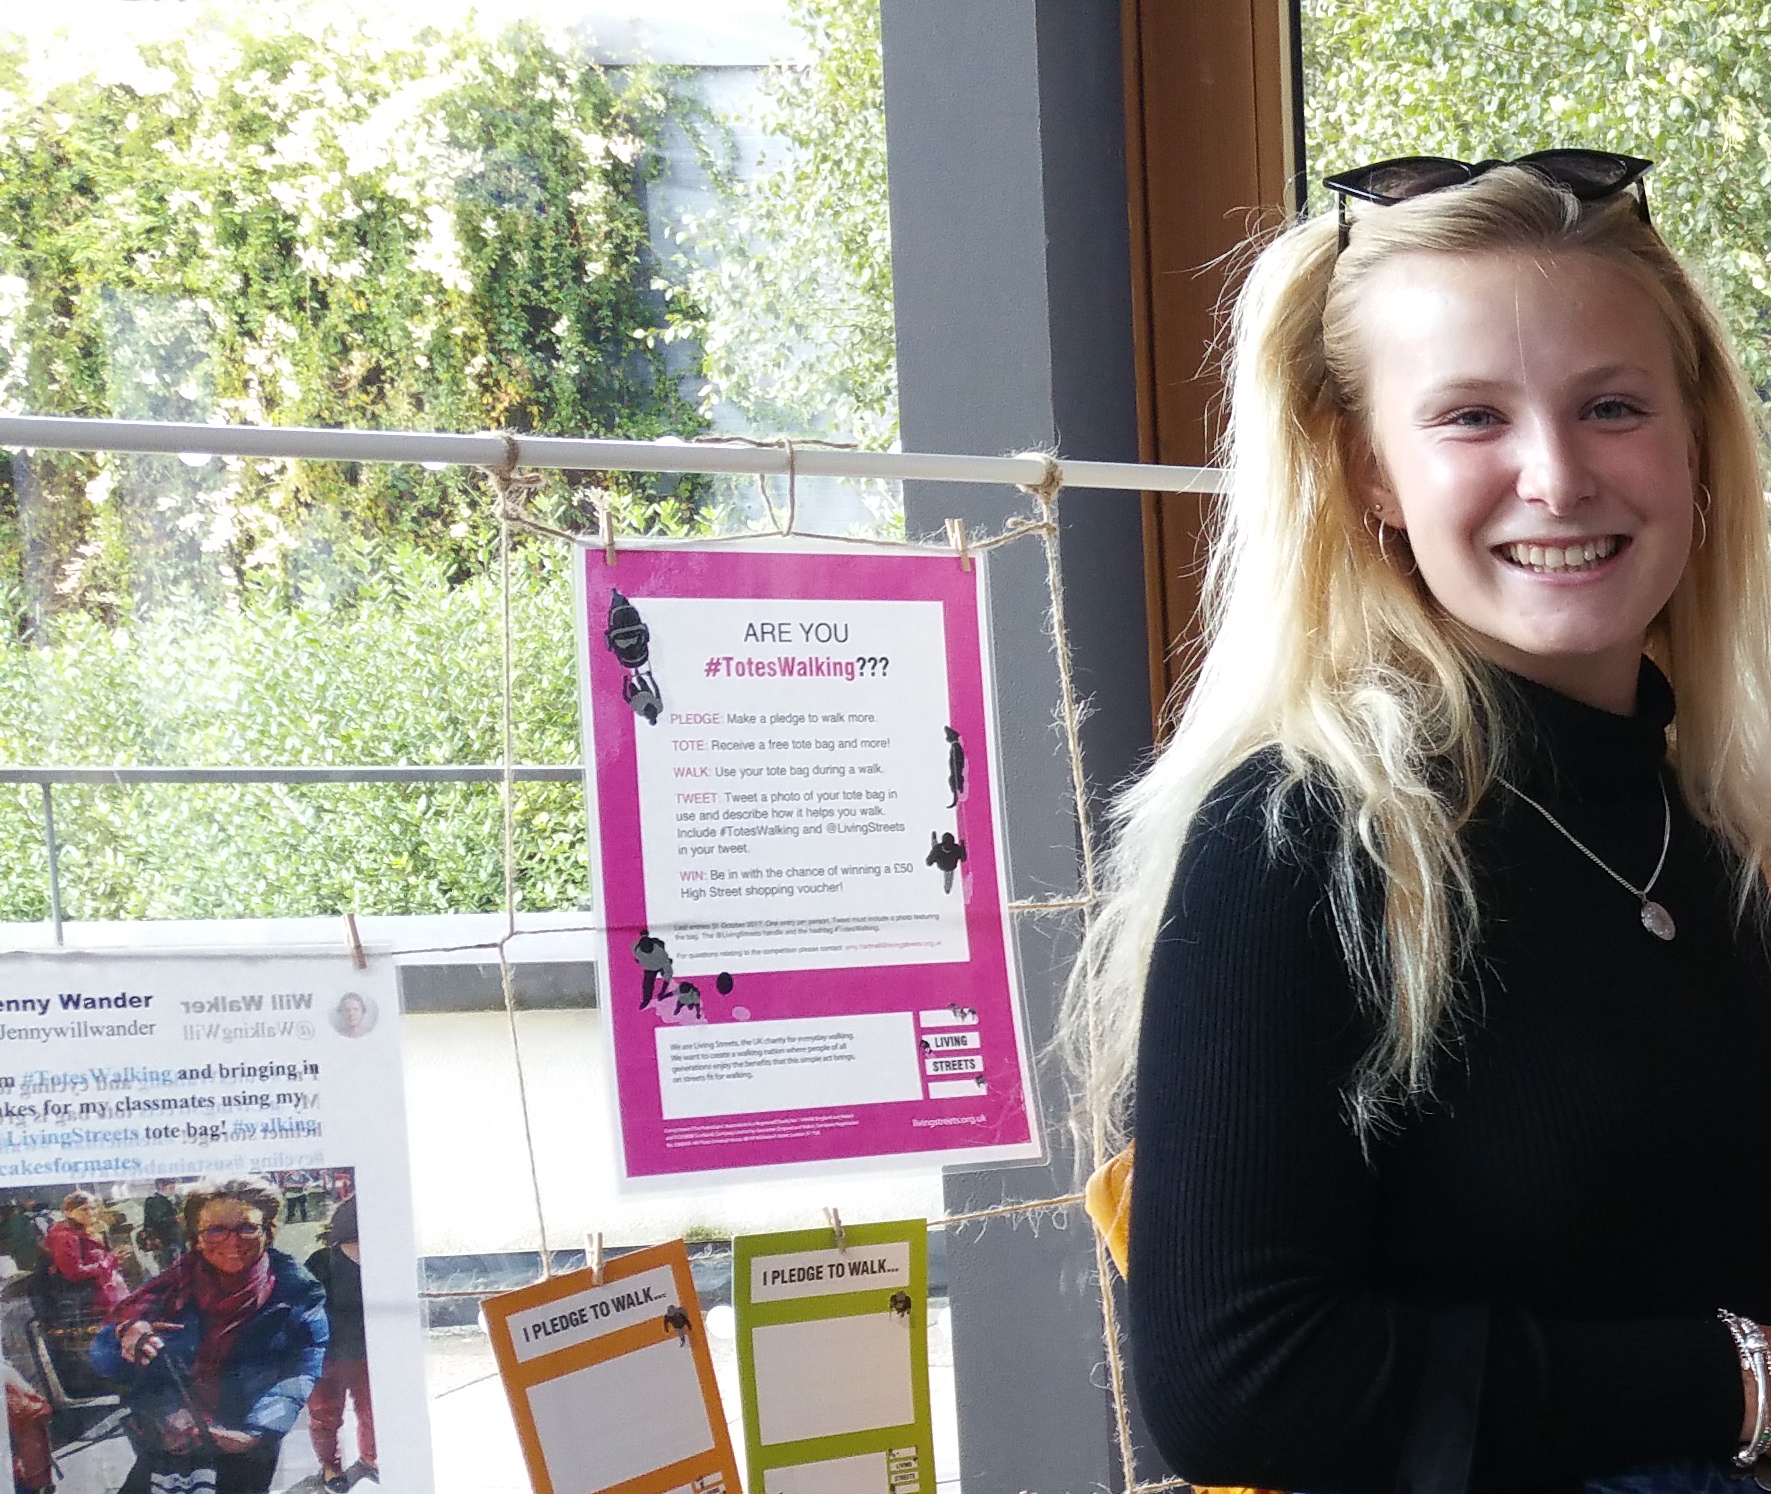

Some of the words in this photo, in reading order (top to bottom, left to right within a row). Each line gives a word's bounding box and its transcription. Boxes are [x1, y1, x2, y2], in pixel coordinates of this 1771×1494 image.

[743, 622, 792, 643] ARE
[799, 623, 849, 643] YOU
[703, 656, 890, 682] #TotesWalking???
[726, 713, 756, 723] Make
[759, 715, 766, 723] a
[769, 712, 805, 726] pledge
[807, 713, 818, 722] to
[820, 712, 845, 722] walk
[710, 739, 755, 750] Receive
[758, 741, 765, 749] a
[768, 738, 789, 749] free
[791, 739, 812, 749] tote
[814, 738, 835, 751] bag
[837, 737, 857, 748] and
[860, 737, 890, 748] more!
[714, 765, 736, 777] Use
[739, 767, 764, 779] your
[766, 765, 787, 776] tote
[789, 764, 809, 778] bag
[812, 763, 845, 777] during
[848, 766, 855, 774] a
[724, 791, 757, 803] Tweet
[760, 793, 768, 802] a
[770, 790, 801, 804] photo
[802, 790, 814, 801] of
[816, 791, 840, 803] your
[842, 789, 863, 800] tote
[864, 788, 885, 802] bag
[887, 788, 897, 798] in
[675, 812, 695, 821] use
[698, 809, 720, 820] and
[722, 808, 768, 820] describe
[771, 807, 793, 818] how
[796, 808, 803, 817] it
[805, 806, 835, 820] helps
[837, 808, 856, 819] you
[677, 826, 716, 838] Include
[719, 823, 800, 839] #TotesWalking
[802, 823, 822, 834] and
[826, 820, 906, 836] @LivingStreets
[677, 845, 687, 855] in
[690, 846, 715, 857] your
[710, 869, 725, 880] Be
[728, 869, 738, 880] in
[741, 867, 763, 879] with
[765, 867, 783, 878] the
[785, 865, 825, 877] chance
[827, 865, 838, 876] of
[840, 864, 881, 878] winning
[883, 865, 891, 874] a
[893, 862, 914, 873] £50
[680, 886, 706, 901] High
[709, 885, 742, 897] Street
[744, 883, 794, 898] shopping
[796, 881, 843, 893] voucher!
[0, 997, 50, 1016] enny
[58, 992, 153, 1011] Wander
[0, 1019, 156, 1043] Jennywillwander
[934, 1035, 968, 1049] LIVING
[177, 1063, 212, 1080] and
[218, 1061, 298, 1081] bringing
[303, 1059, 320, 1076] in
[932, 1058, 976, 1073] STREETS
[42, 1099, 74, 1116] for
[79, 1101, 109, 1119] my
[116, 1095, 215, 1112] classmates
[222, 1090, 270, 1109] using
[276, 1092, 304, 1113] my
[145, 1123, 180, 1140] tote
[186, 1120, 226, 1141] bag!
[762, 1271, 768, 1286] I
[771, 1265, 824, 1285] PLEDGE
[827, 1262, 845, 1279] TO
[848, 1258, 899, 1277] WALK...
[522, 1327, 530, 1342] I
[532, 1307, 589, 1340] PLEDGE
[590, 1301, 611, 1320] TO
[610, 1286, 667, 1314] WALK...
